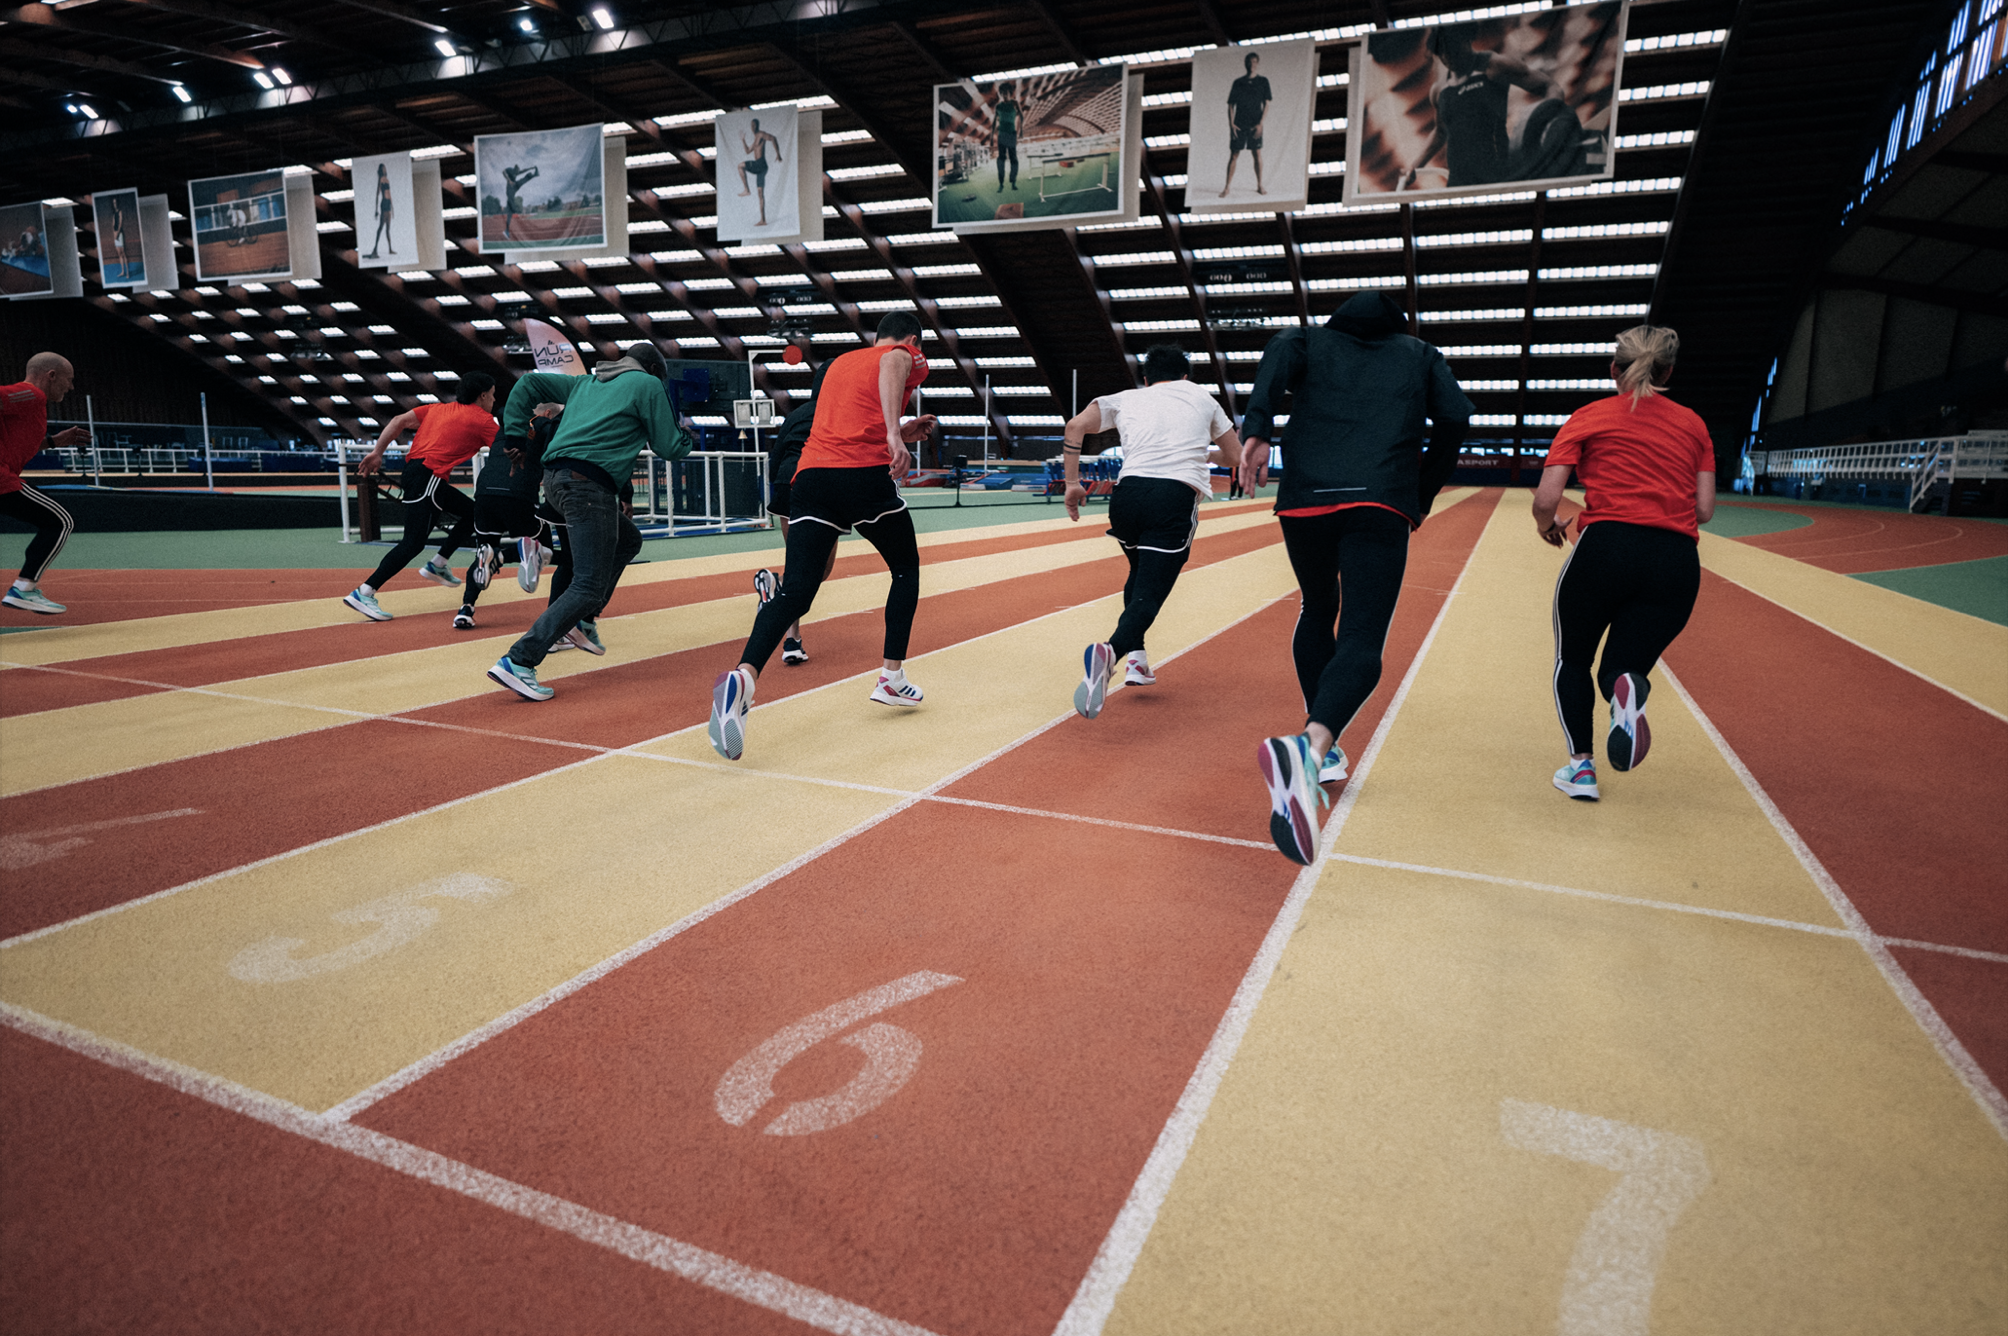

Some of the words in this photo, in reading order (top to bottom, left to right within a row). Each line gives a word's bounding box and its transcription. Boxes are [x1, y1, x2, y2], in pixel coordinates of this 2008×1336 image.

[228, 871, 514, 984] 5
[713, 969, 966, 1137] 6
[1500, 1097, 1711, 1336] 7
